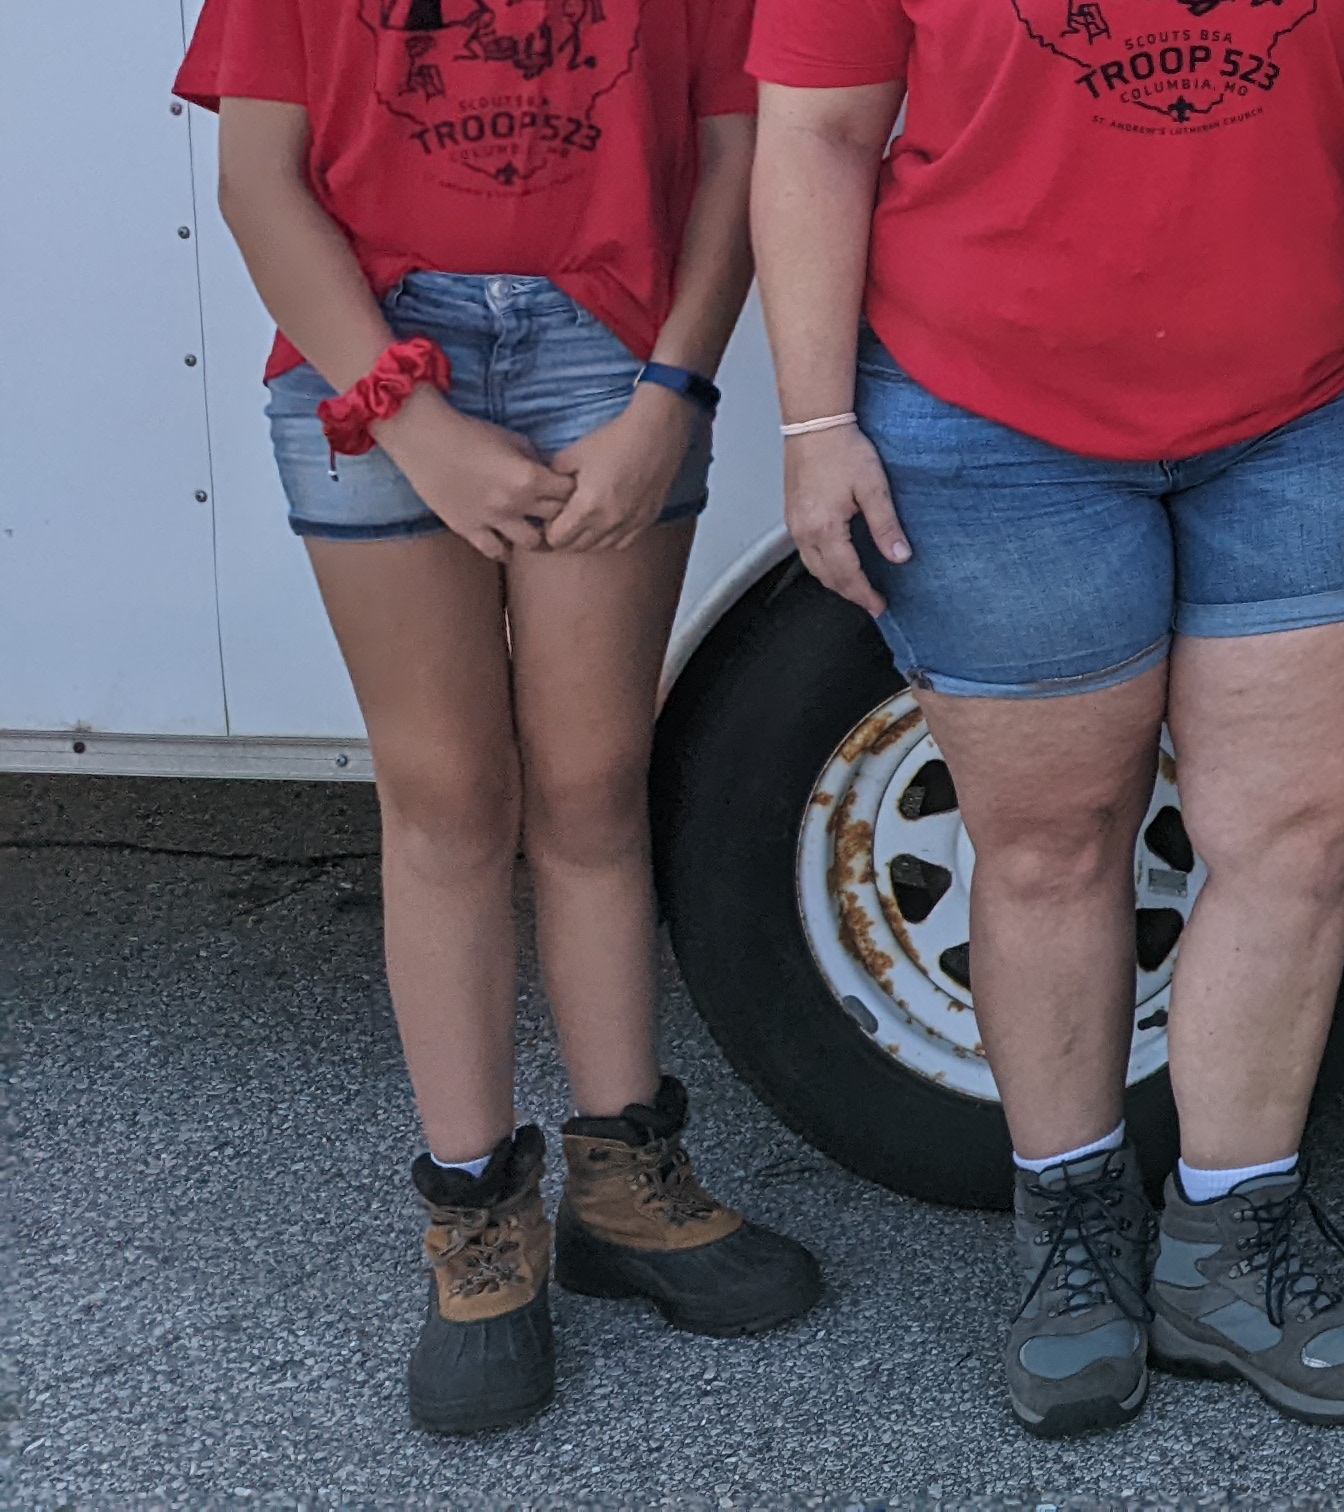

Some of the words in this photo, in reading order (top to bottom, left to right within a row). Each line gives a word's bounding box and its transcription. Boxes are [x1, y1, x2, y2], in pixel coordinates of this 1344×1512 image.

[1125, 29, 1191, 51] SCOUTS
[1200, 29, 1233, 44] BSA
[1075, 44, 1213, 99] TROOP
[1219, 47, 1281, 92] 523
[1223, 80, 1249, 97] MO
[411, 111, 538, 155] TROOP
[541, 113, 602, 153] 523
